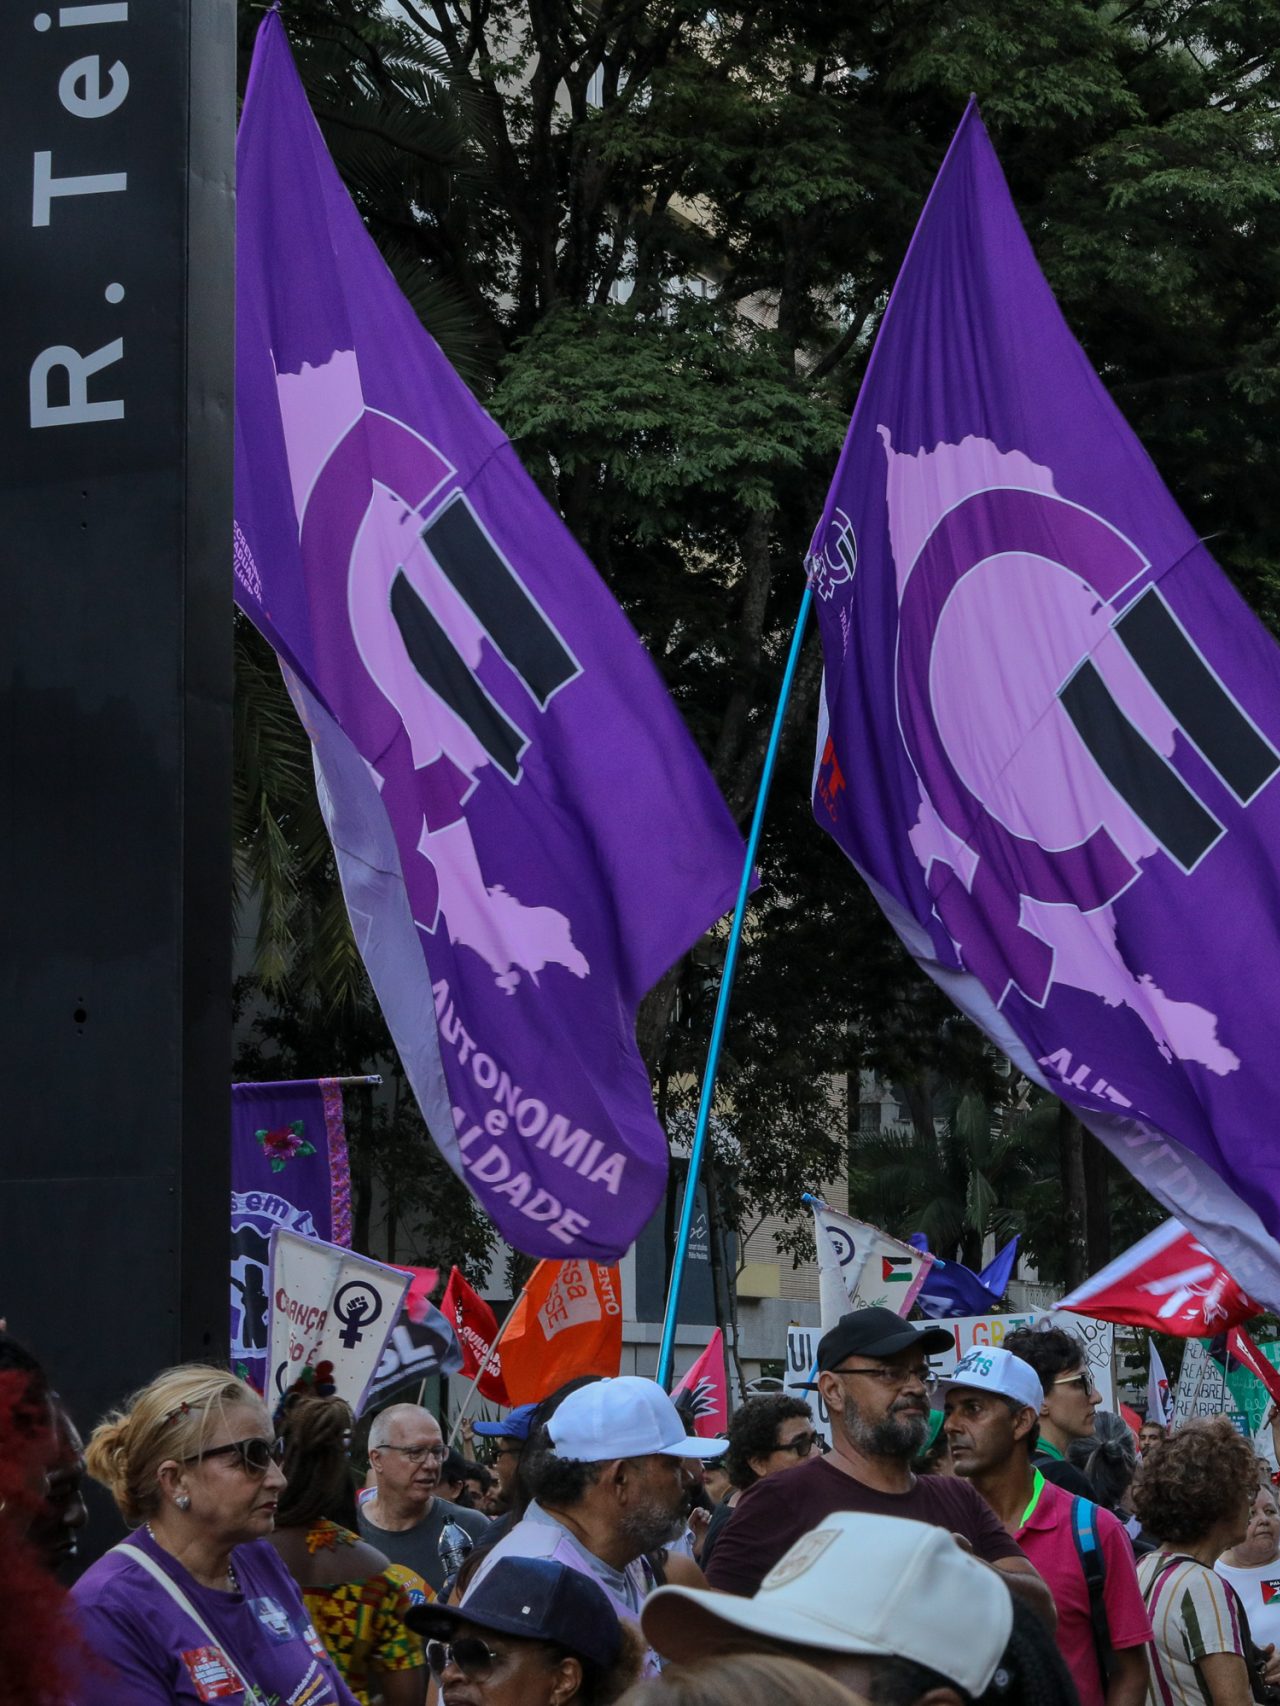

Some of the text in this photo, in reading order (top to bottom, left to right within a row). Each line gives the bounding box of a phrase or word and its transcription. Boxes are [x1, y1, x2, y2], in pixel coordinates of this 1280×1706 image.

[29, 281, 126, 428] R.
[484, 1108, 509, 1136] e
[275, 1287, 328, 1335] CANÇA
